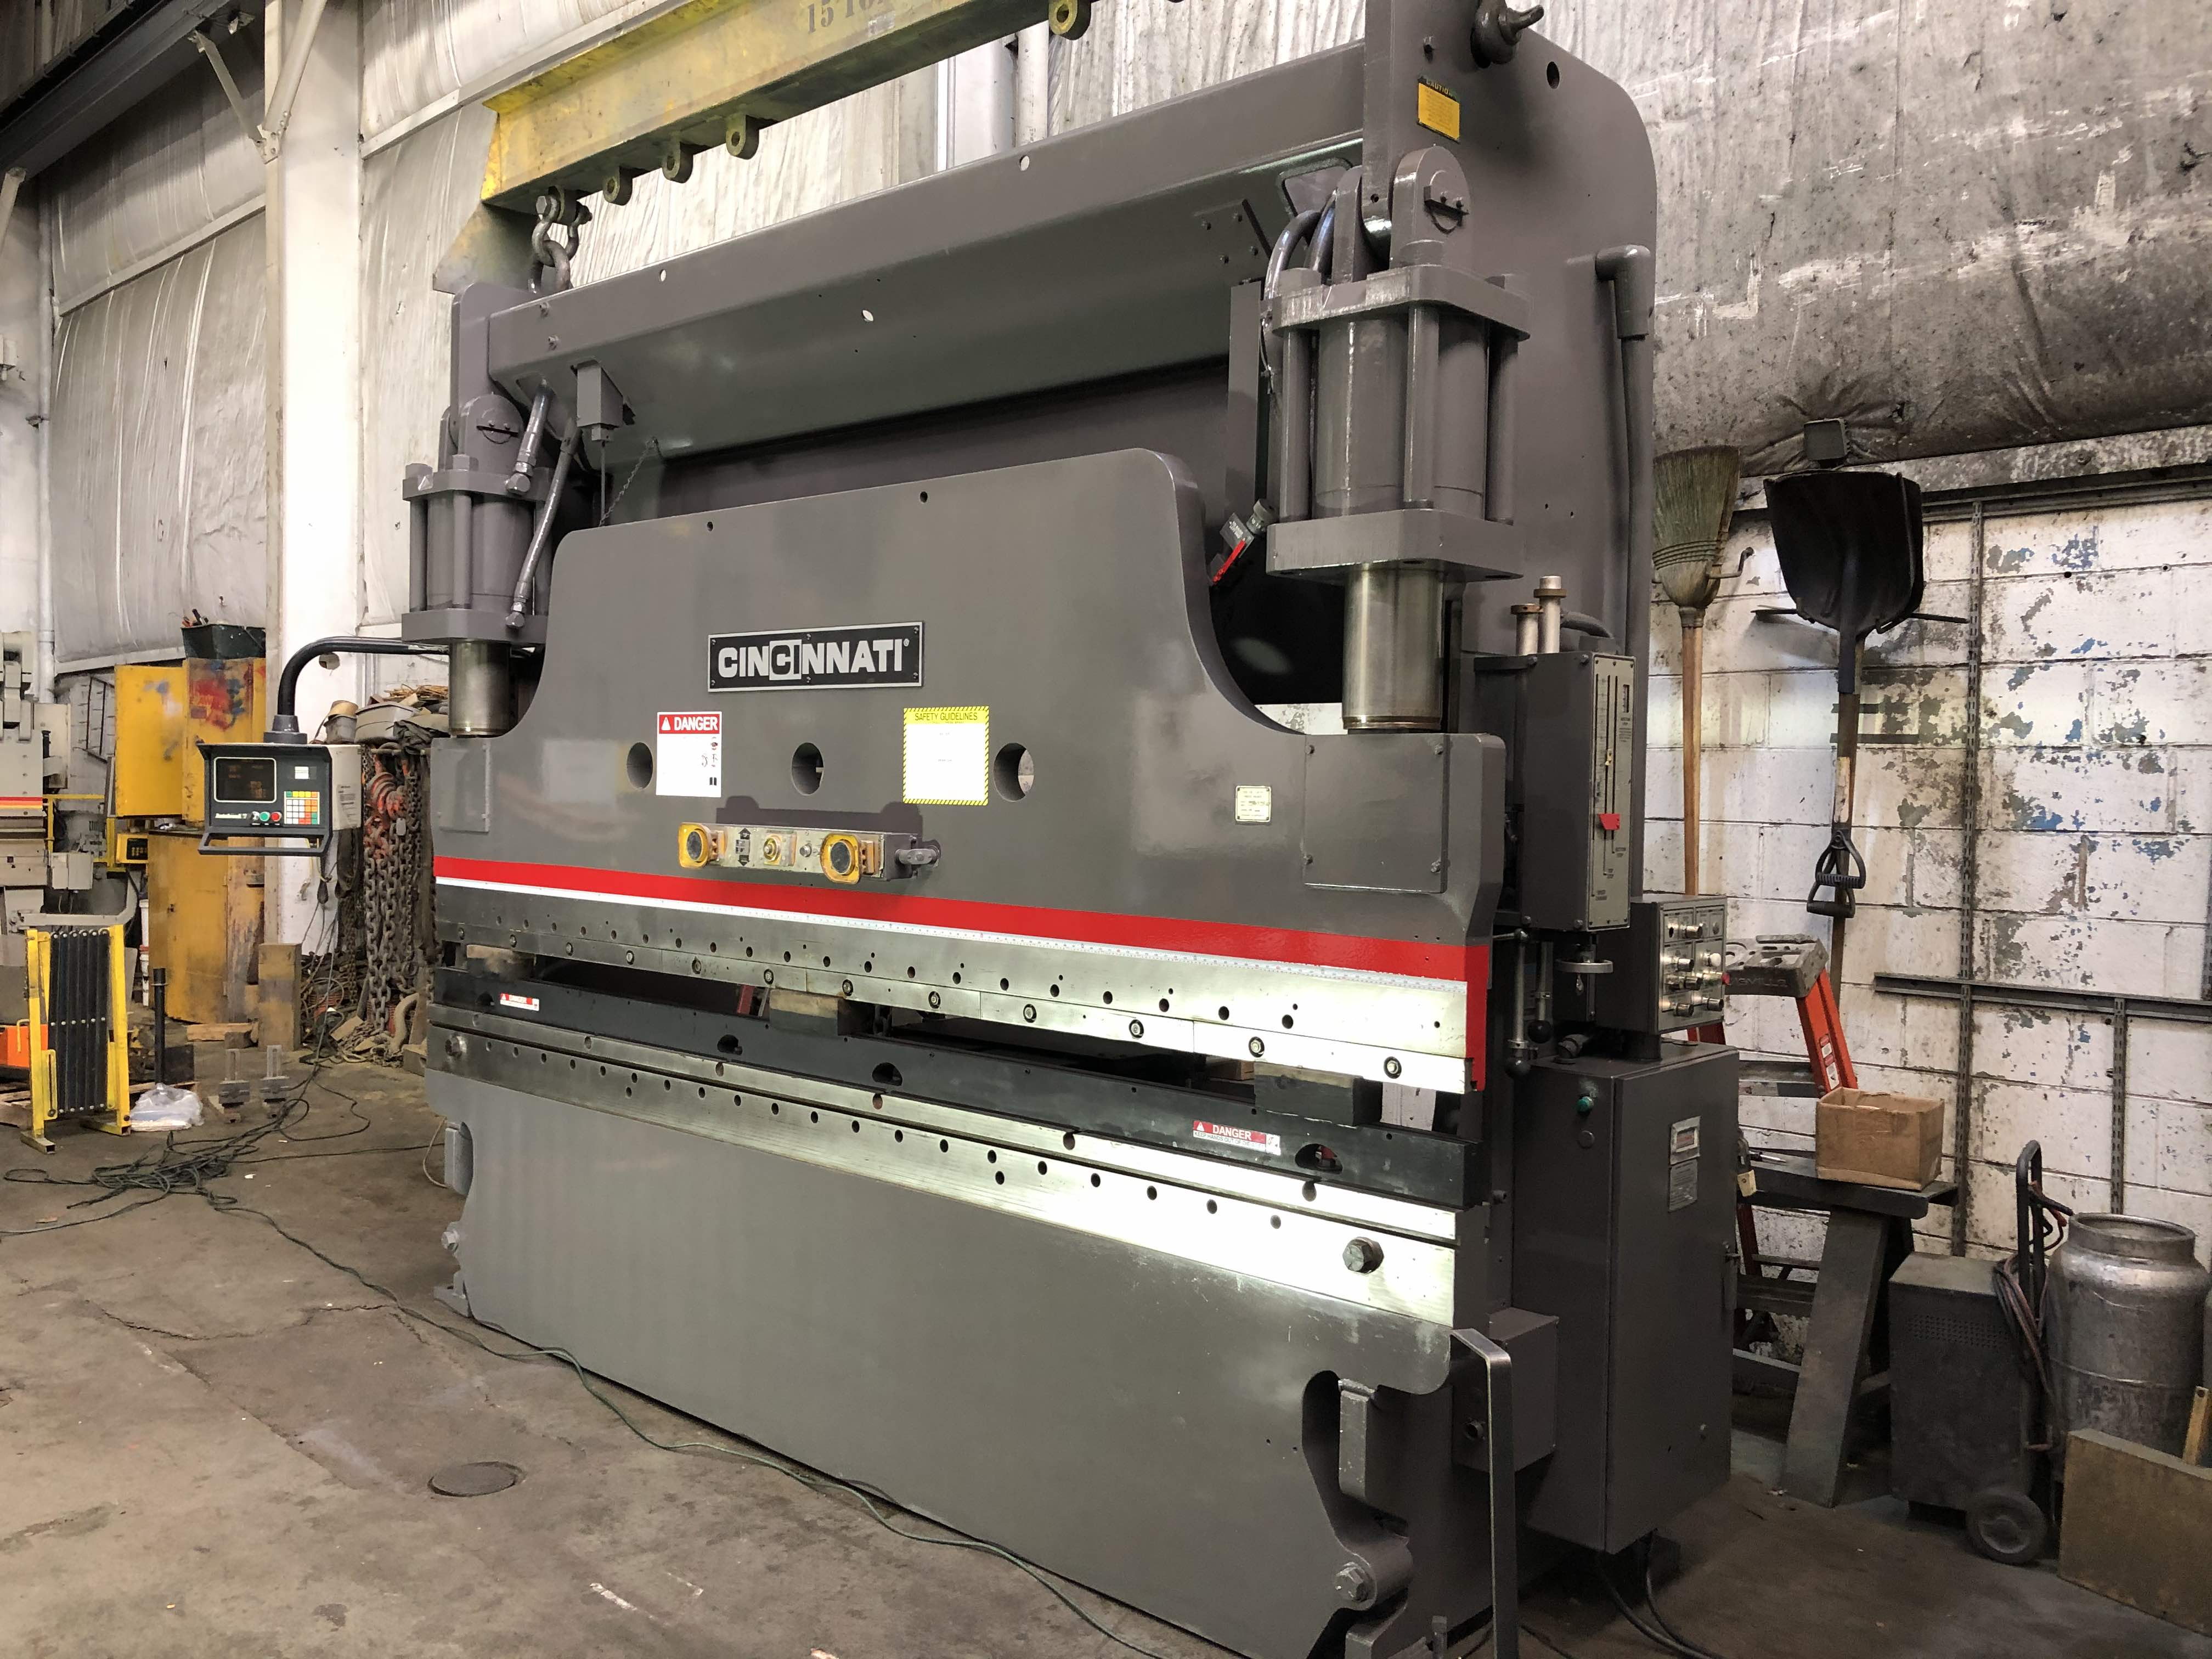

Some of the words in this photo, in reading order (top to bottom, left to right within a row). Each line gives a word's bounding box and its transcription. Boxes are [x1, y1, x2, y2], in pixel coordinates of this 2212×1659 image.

[718, 639, 903, 680] CINCINNATI
[674, 716, 718, 731] DANGER
[915, 713, 938, 721] SAFETY
[940, 712, 978, 721] GUIDELINES
[1207, 1133, 1223, 1142] HANDS
[1212, 1124, 1252, 1141] DANGER
